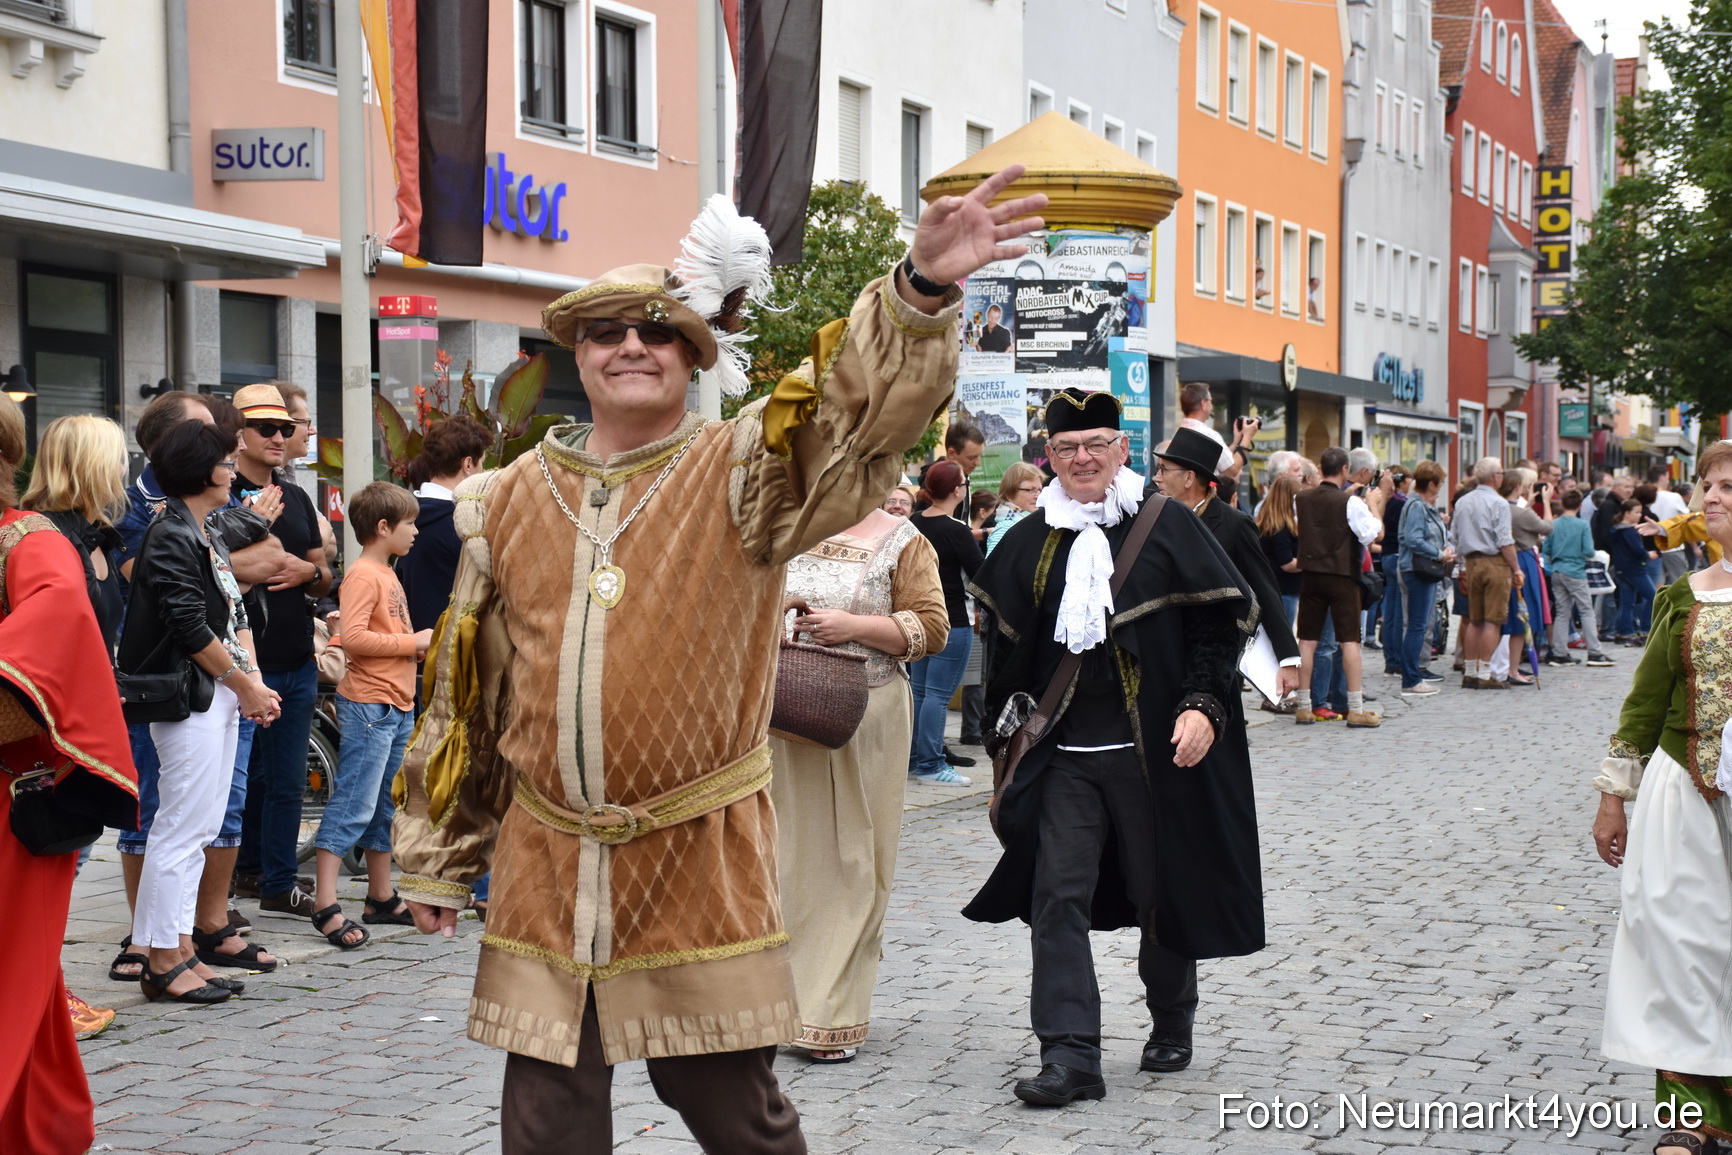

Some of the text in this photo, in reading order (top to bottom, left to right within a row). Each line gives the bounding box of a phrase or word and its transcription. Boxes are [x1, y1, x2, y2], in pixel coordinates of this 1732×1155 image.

[215, 136, 310, 169] sutor.
[1538, 168, 1572, 331] HOTE
[966, 285, 1012, 296] WIGGERL
[1017, 286, 1043, 298] ADAC
[990, 295, 1009, 304] LIVE
[1016, 294, 1070, 309] NORDBAYERN
[1094, 292, 1108, 303] CUP
[1025, 308, 1065, 319] MOTOCROSS
[386, 327, 411, 336] HotSpot
[962, 381, 1006, 393] FELSENFEST
[962, 389, 1020, 402] DEINSCHWANG
